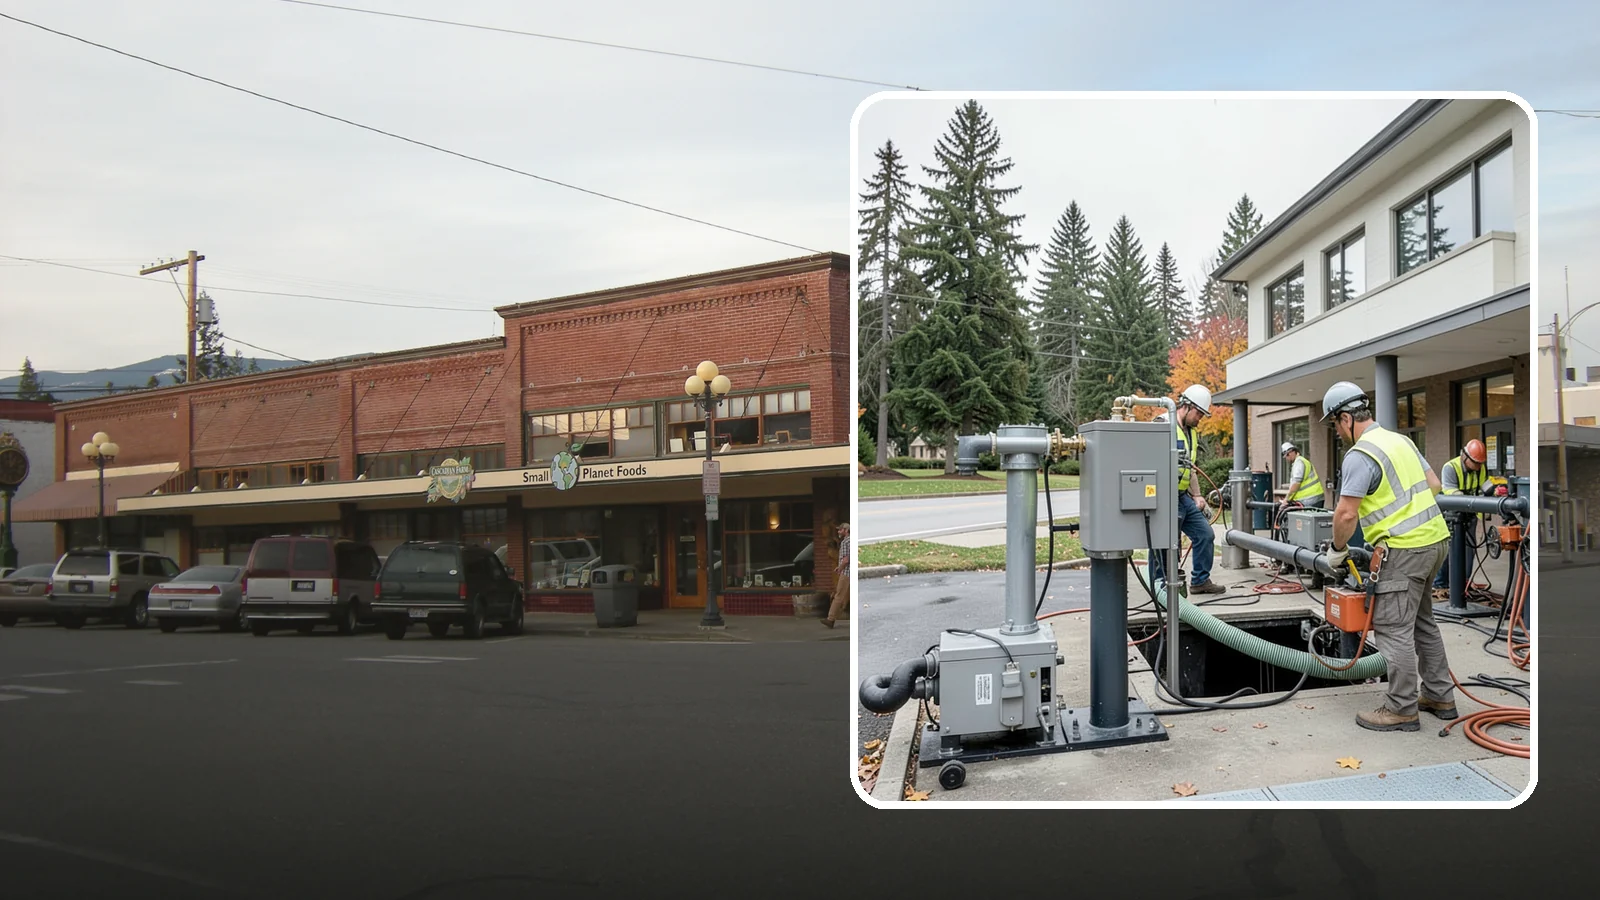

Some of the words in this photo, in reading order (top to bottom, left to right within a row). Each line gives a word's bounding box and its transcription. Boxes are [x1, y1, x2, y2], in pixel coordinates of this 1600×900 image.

[523, 471, 548, 483] Small
[582, 468, 614, 479] Planet
[617, 464, 647, 477] Foods
